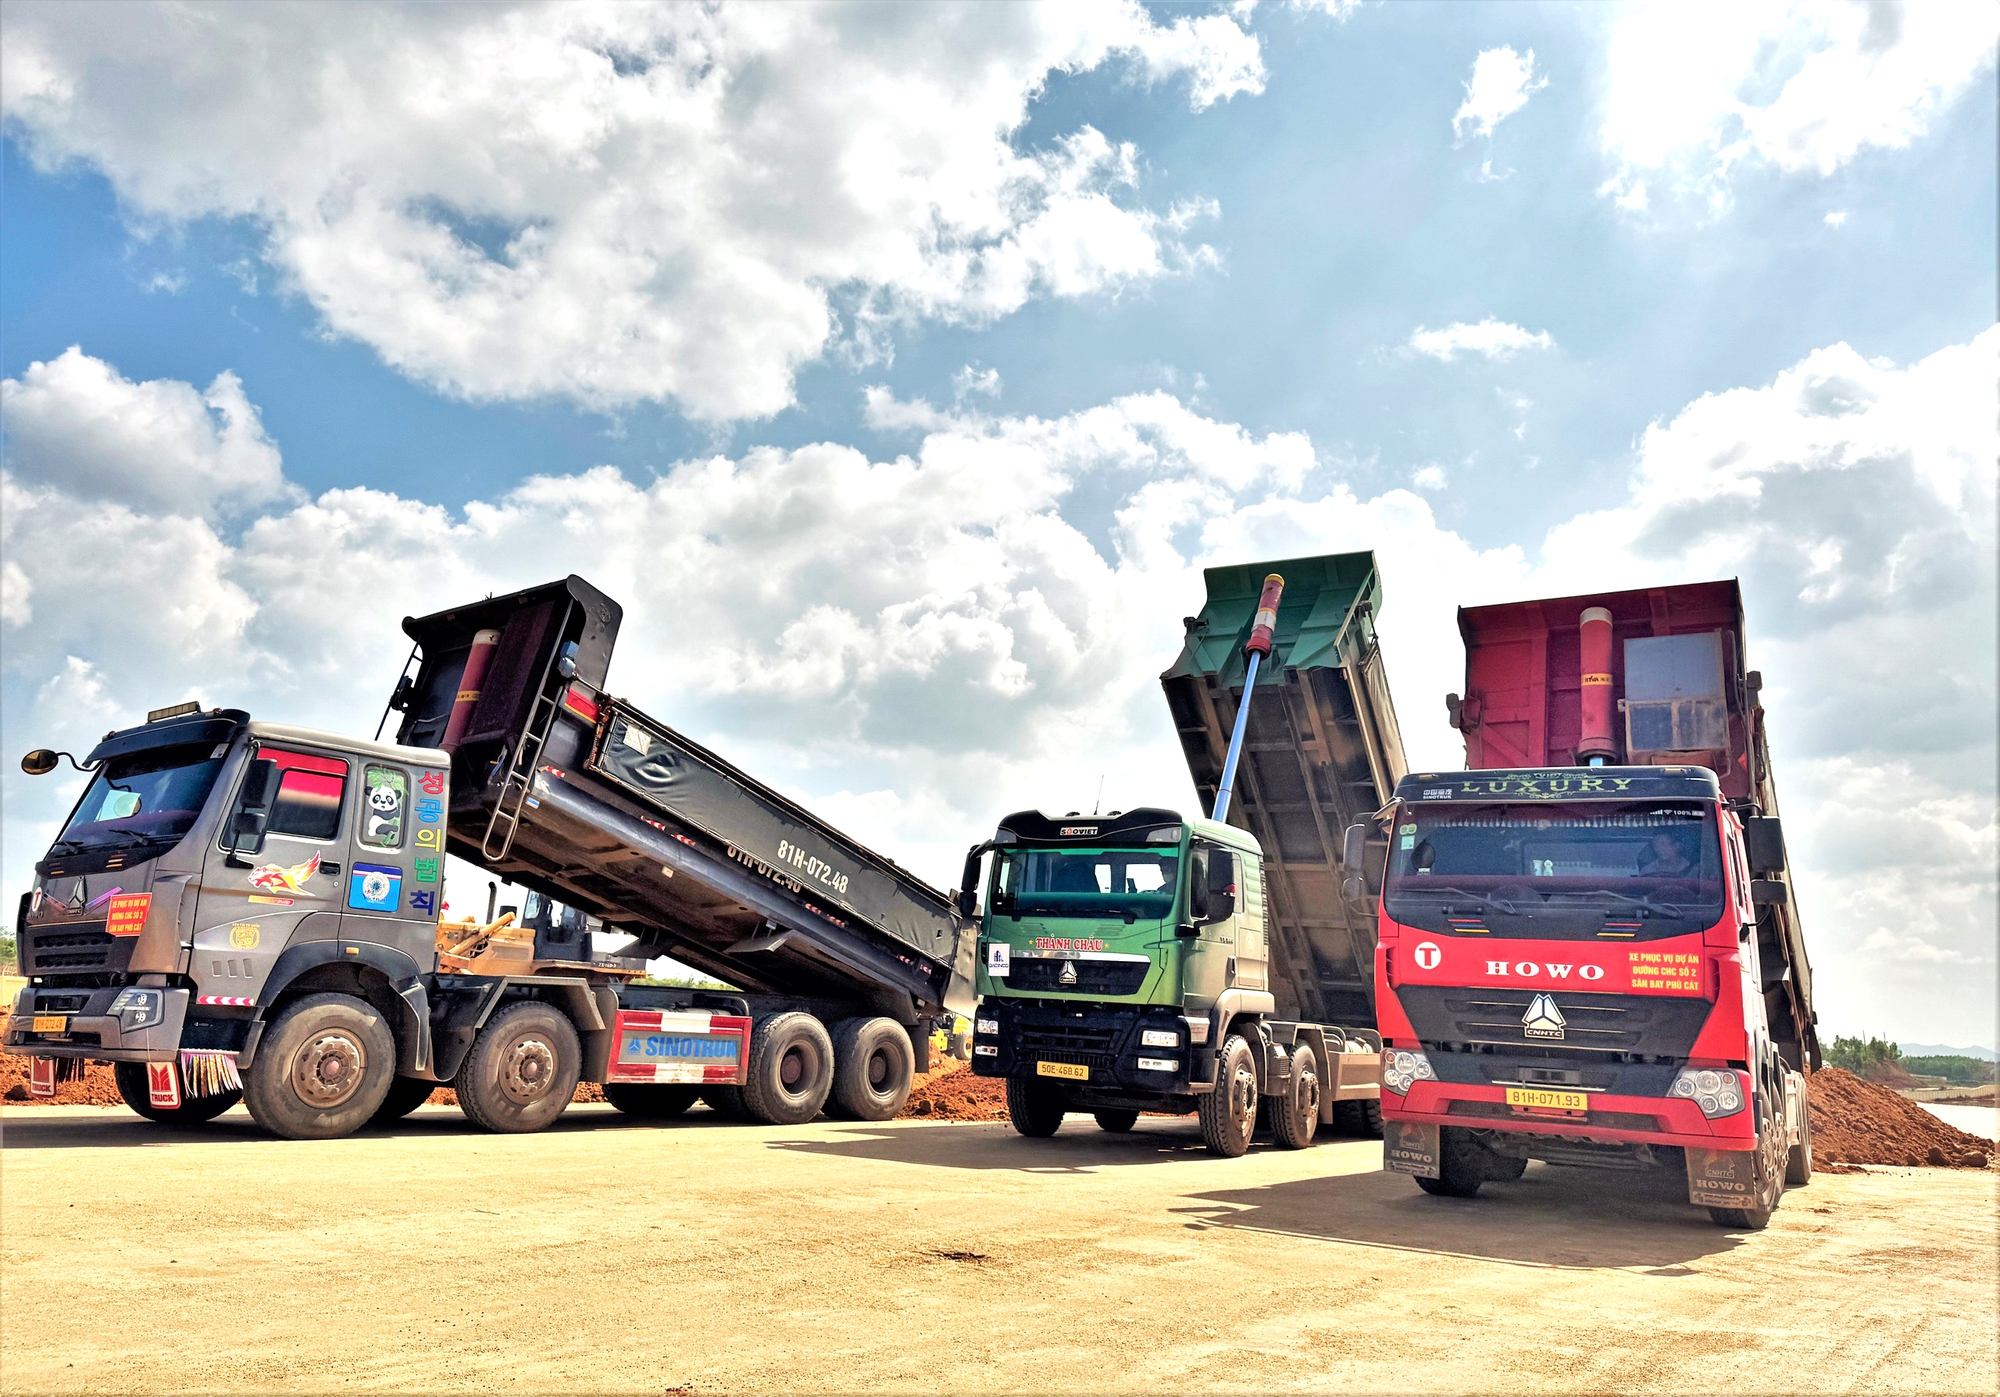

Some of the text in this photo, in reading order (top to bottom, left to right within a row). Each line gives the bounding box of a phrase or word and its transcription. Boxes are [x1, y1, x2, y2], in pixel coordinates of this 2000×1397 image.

[1461, 778, 1633, 793] LUXURY
[777, 839, 849, 894] 81H-072.48
[1036, 933, 1104, 951] THÀNH CHÂU
[1418, 947, 1437, 967] T
[1629, 952, 1699, 965] XE PHỤC VỤ DỰ ÁN
[1485, 961, 1604, 980] HOWO
[1661, 967, 1677, 976] CHC
[1679, 966, 1689, 977] SỐ
[1691, 968, 1697, 977] 2
[1631, 978, 1648, 988] SÂN
[1650, 980, 1664, 989] BAY
[1684, 980, 1699, 990] CÁT
[1527, 1029, 1561, 1037] CNHTC
[151, 1093, 174, 1103] TRUCK
[1512, 1091, 1580, 1107] 81H-071.93
[1391, 1150, 1432, 1163] HOWO
[1696, 1179, 1746, 1192] HOWO
